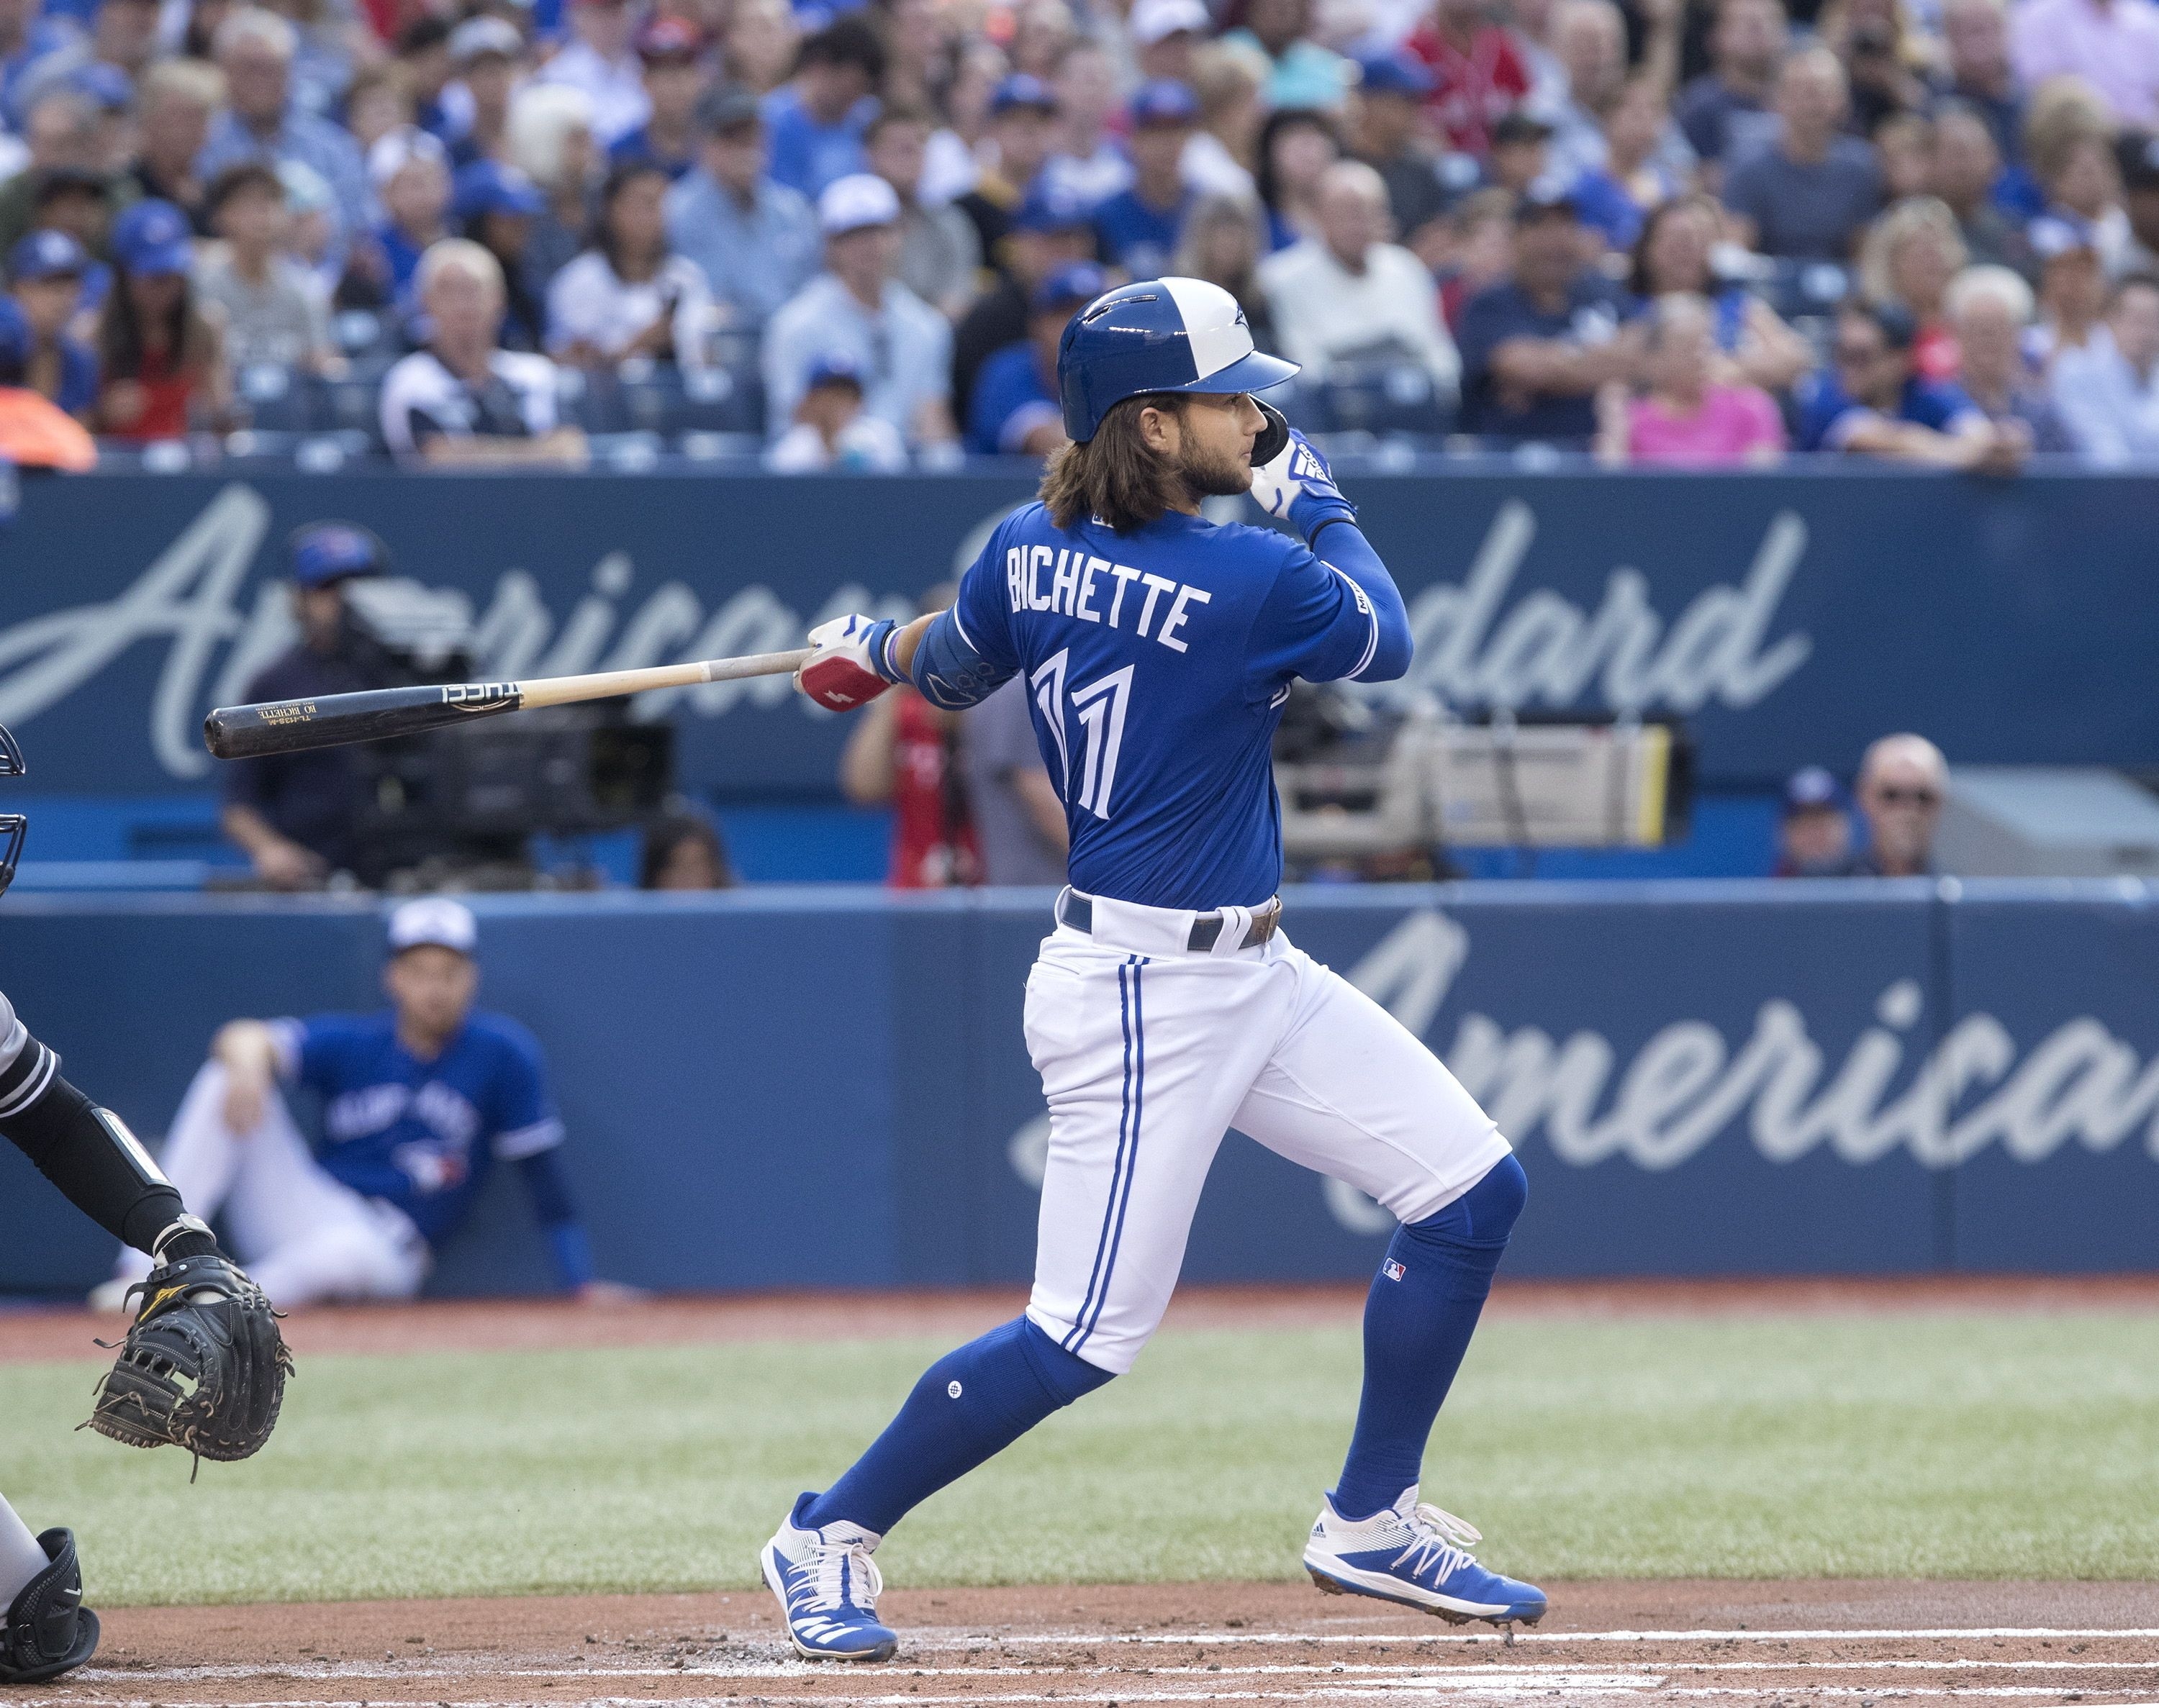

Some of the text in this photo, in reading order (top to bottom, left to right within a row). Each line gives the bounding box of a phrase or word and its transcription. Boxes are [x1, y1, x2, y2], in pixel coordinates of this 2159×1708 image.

[1298, 442, 1329, 480] didas
[1008, 545, 1212, 653] BICHETTE
[258, 705, 317, 719] BO BICHETTE
[442, 683, 519, 704] TUCCI
[1029, 647, 1136, 821] 11
[1008, 908, 2159, 1233] merica
